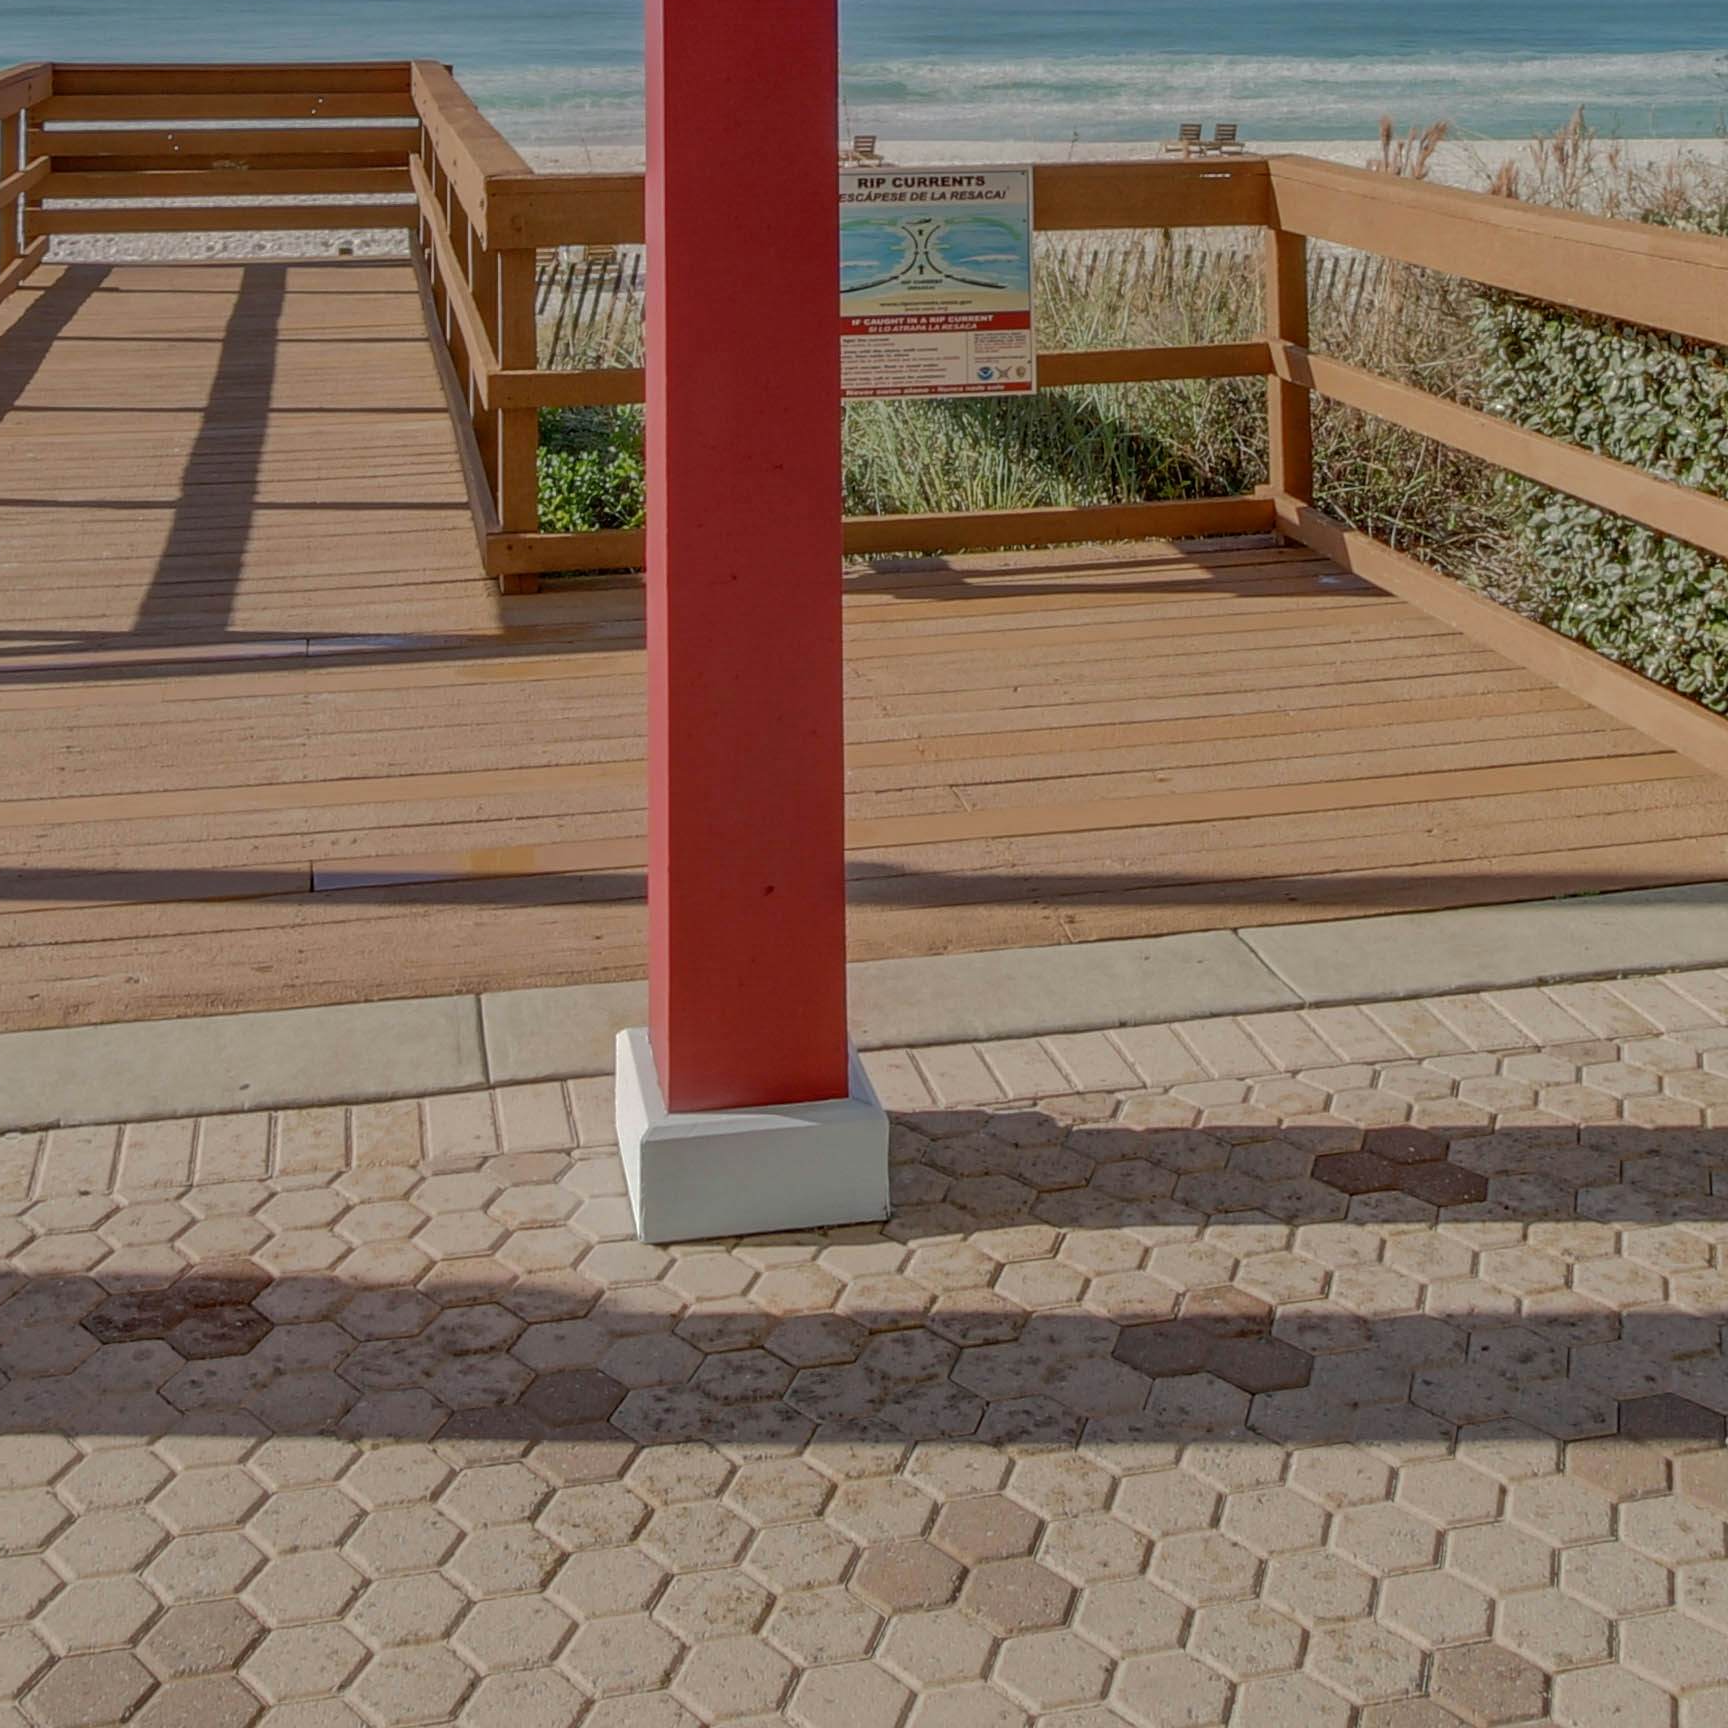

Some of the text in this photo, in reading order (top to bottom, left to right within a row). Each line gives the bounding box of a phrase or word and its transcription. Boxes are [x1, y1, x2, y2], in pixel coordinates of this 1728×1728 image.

[857, 175, 985, 189] RIP CURRENTS
[910, 191, 927, 202] DE
[930, 191, 946, 201] LA
[863, 317, 905, 326] CAUGHT
[907, 316, 918, 324] IN
[920, 316, 928, 324] A
[929, 315, 946, 323] RIP
[948, 314, 994, 323] CURRENT
